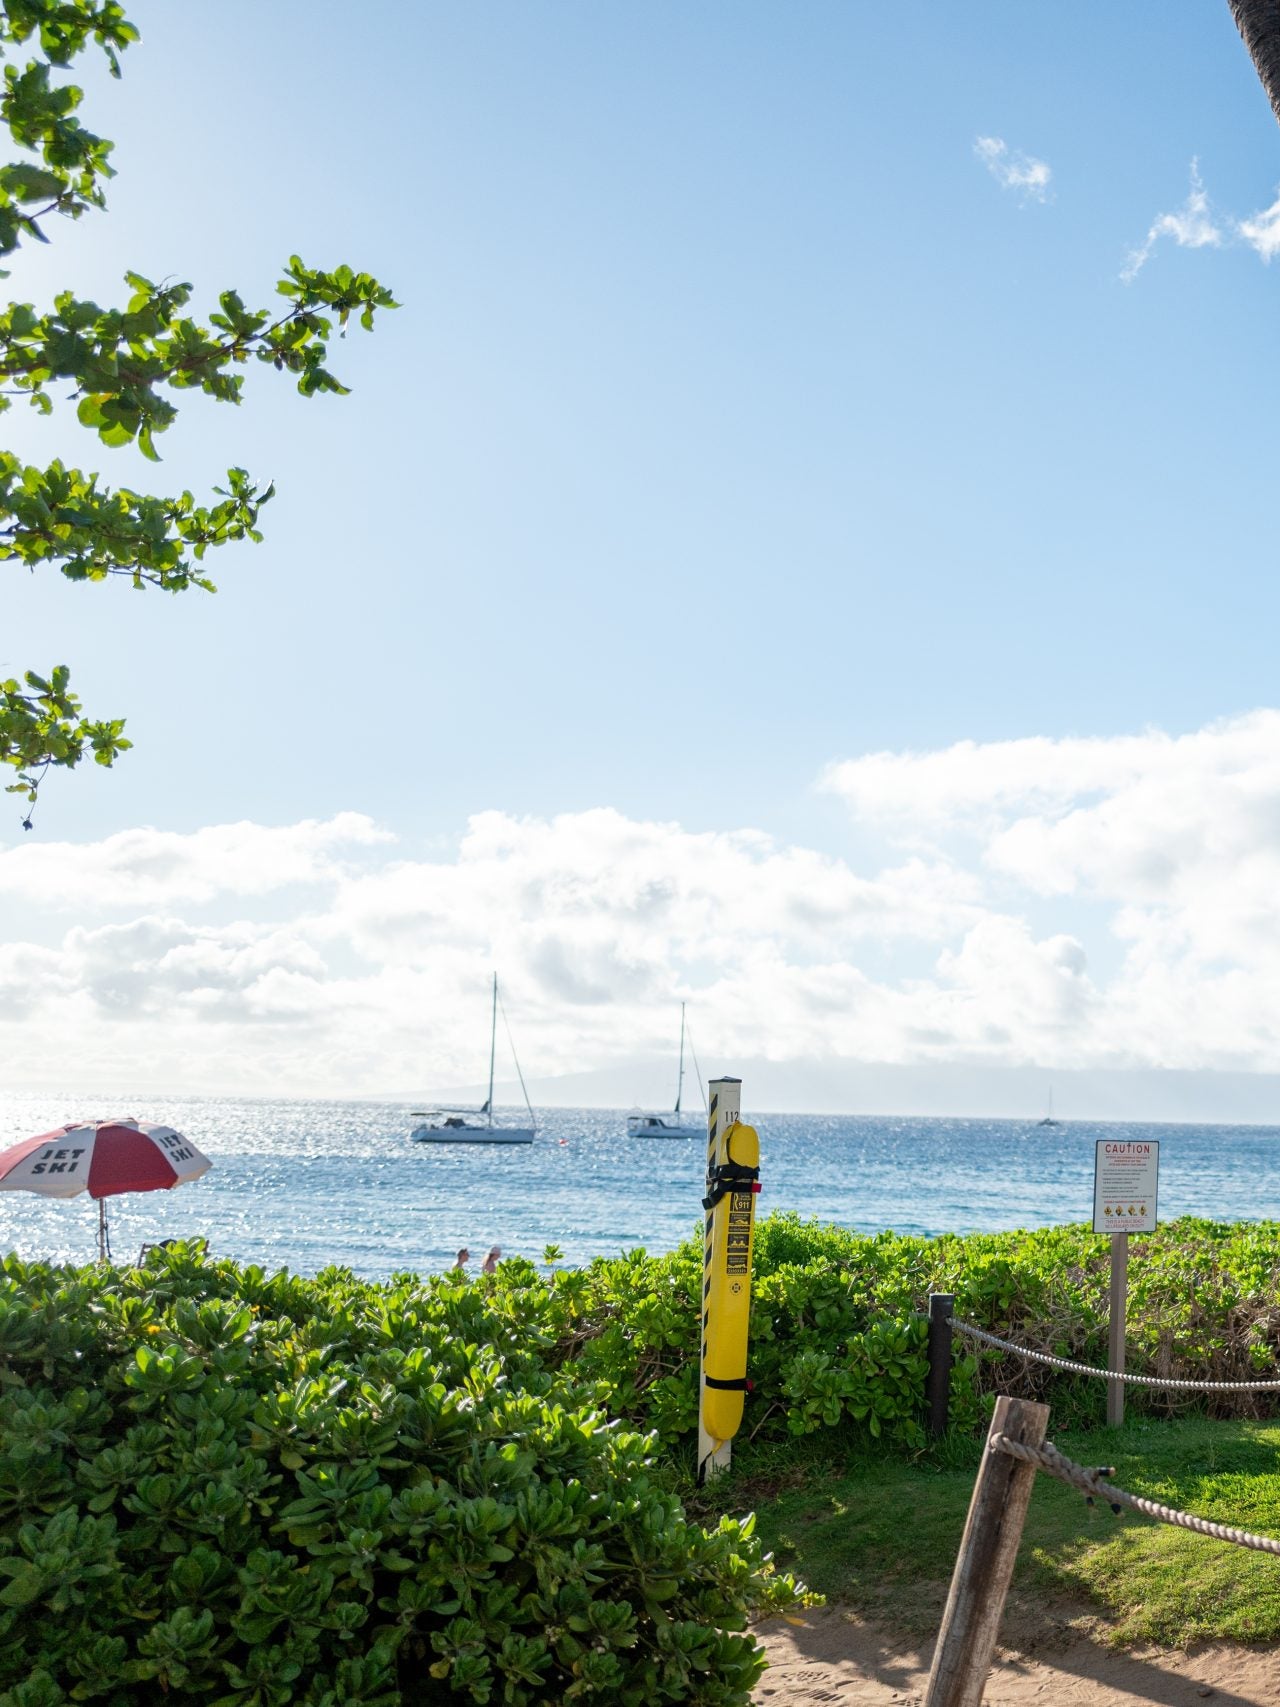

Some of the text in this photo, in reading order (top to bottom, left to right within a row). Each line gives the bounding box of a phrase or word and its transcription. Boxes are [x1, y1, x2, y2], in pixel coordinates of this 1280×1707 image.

[725, 1111, 739, 1123] 112
[158, 1134, 183, 1149] JET
[41, 1149, 85, 1160] JET
[169, 1147, 195, 1162] SKI
[1105, 1144, 1150, 1154] CAUTION
[31, 1162, 79, 1174] SKI
[738, 1201, 750, 1209] 911
